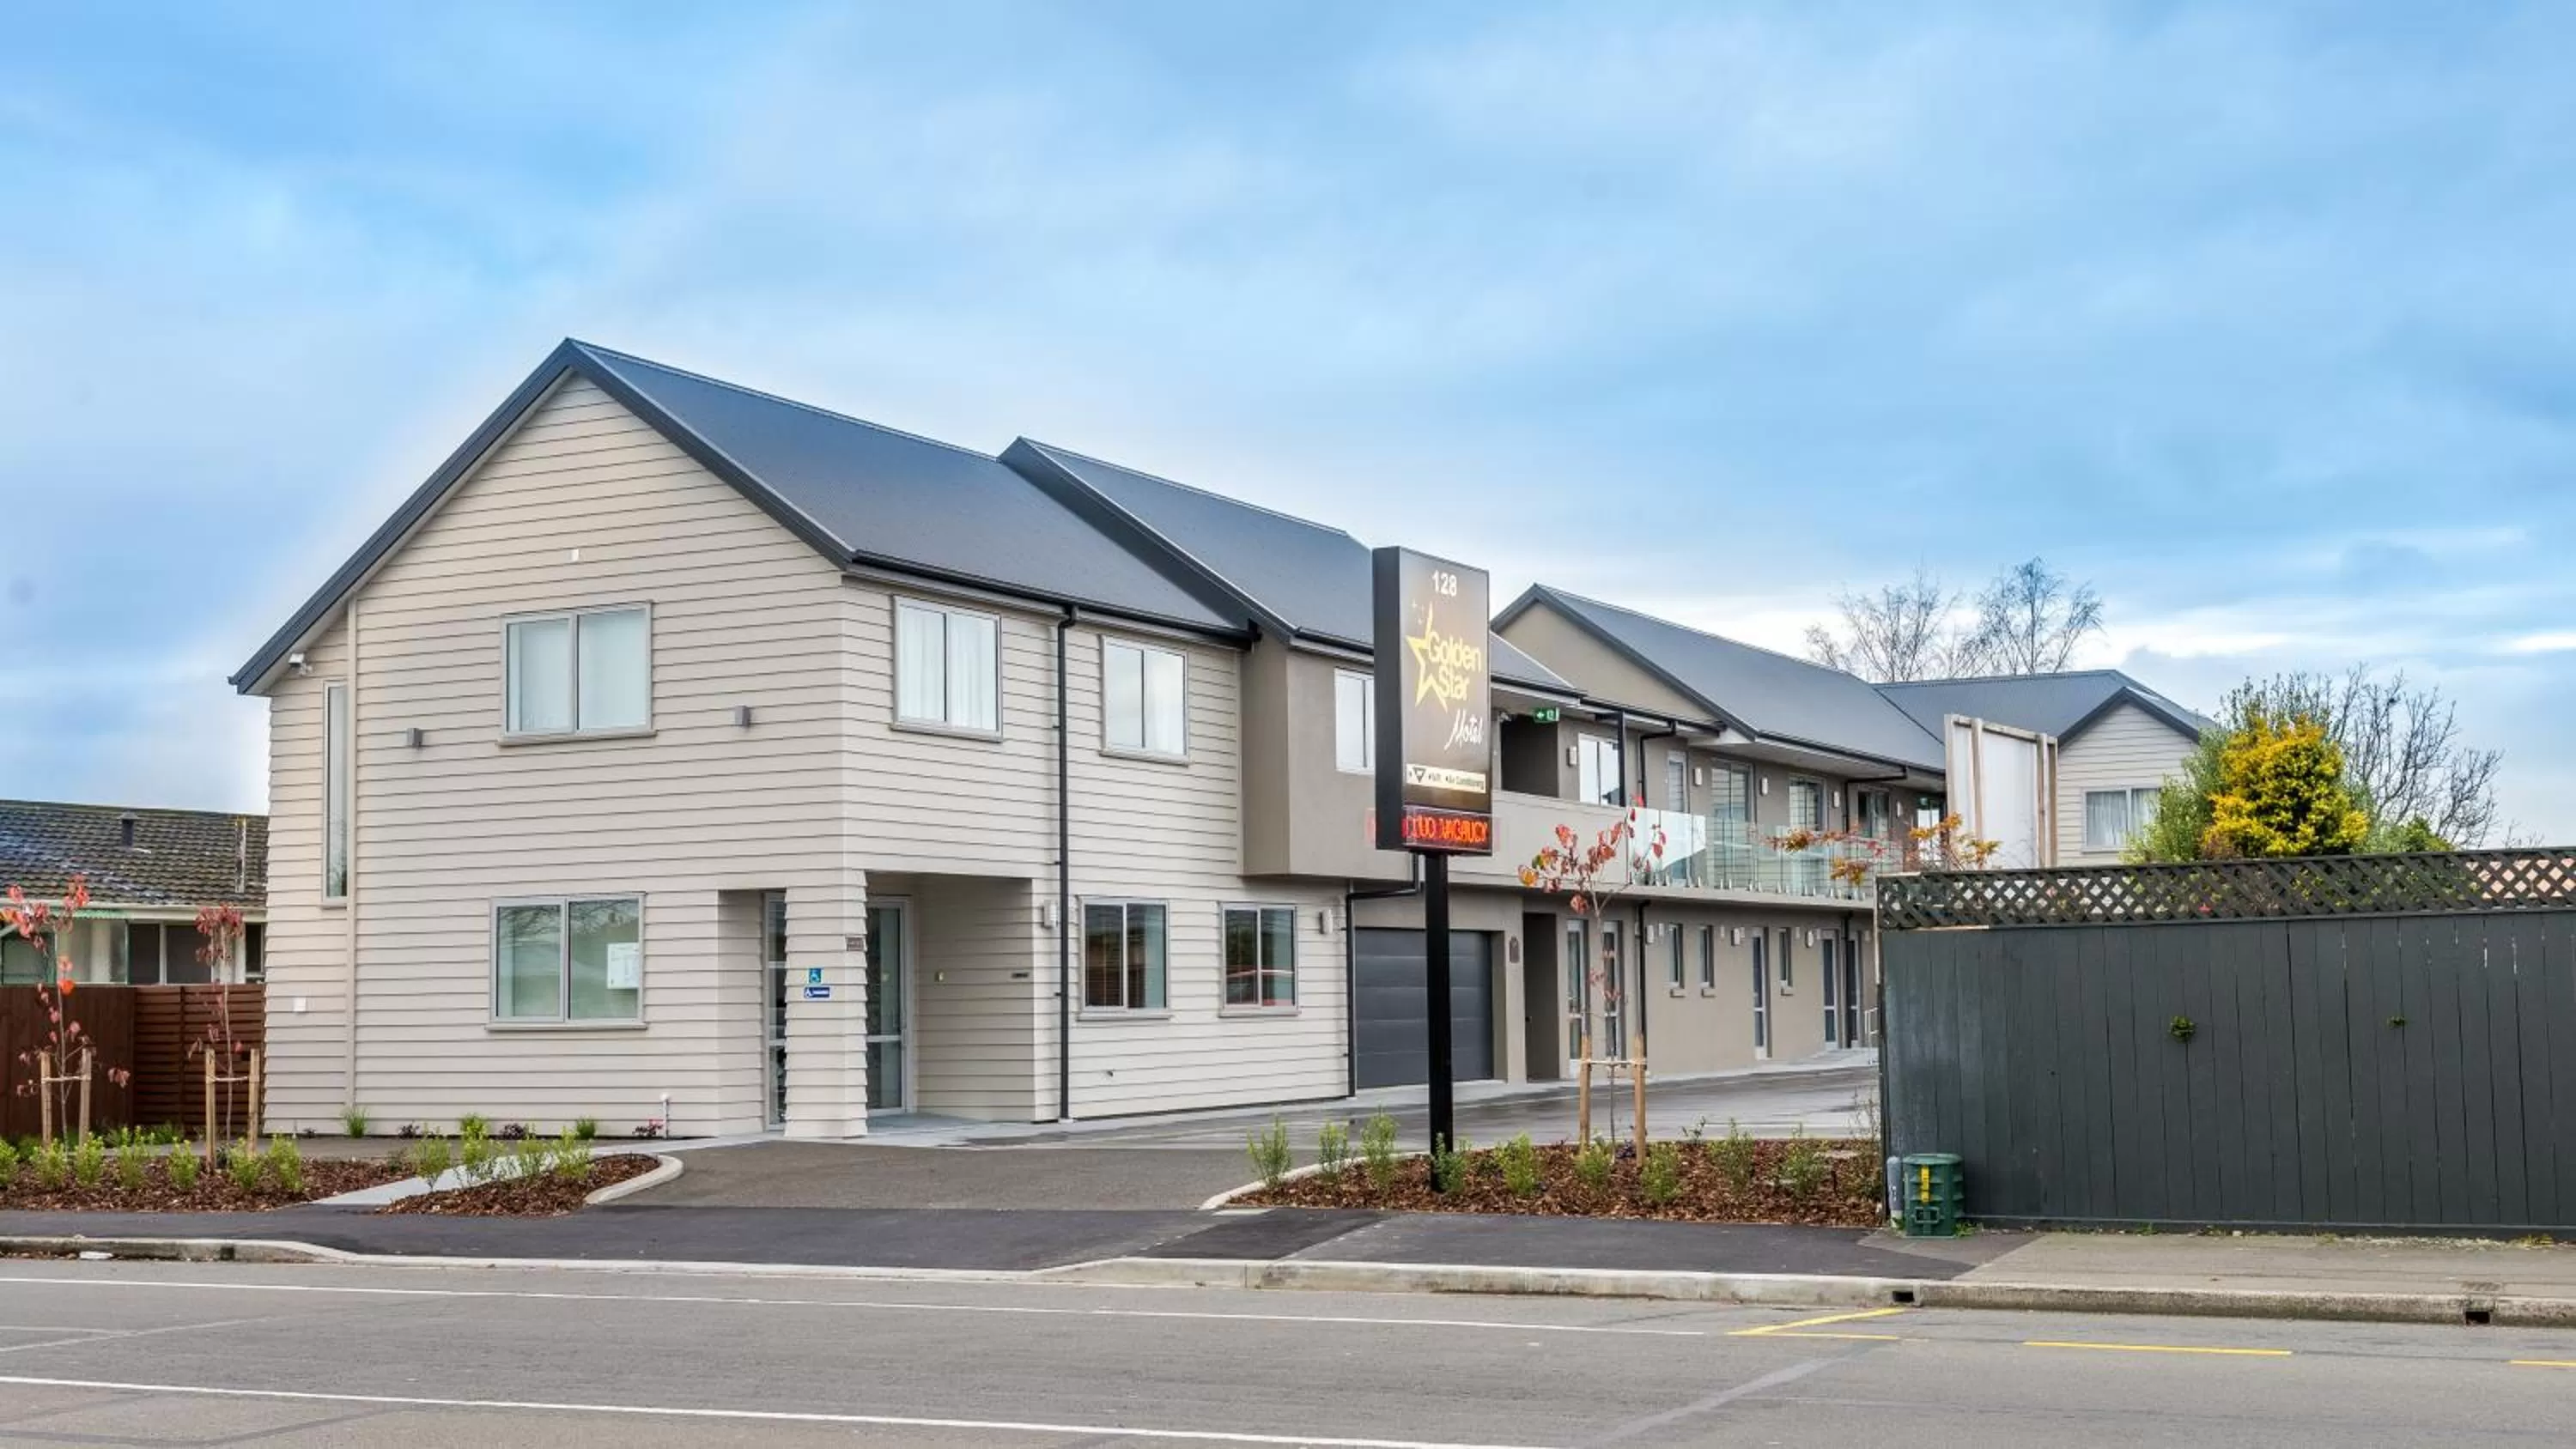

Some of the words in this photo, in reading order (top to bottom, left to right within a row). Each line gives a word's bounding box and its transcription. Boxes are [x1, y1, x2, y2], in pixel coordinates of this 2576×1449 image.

[1431, 569, 1458, 597] 128
[1428, 629, 1481, 673] Golden
[1438, 665, 1471, 701] Star
